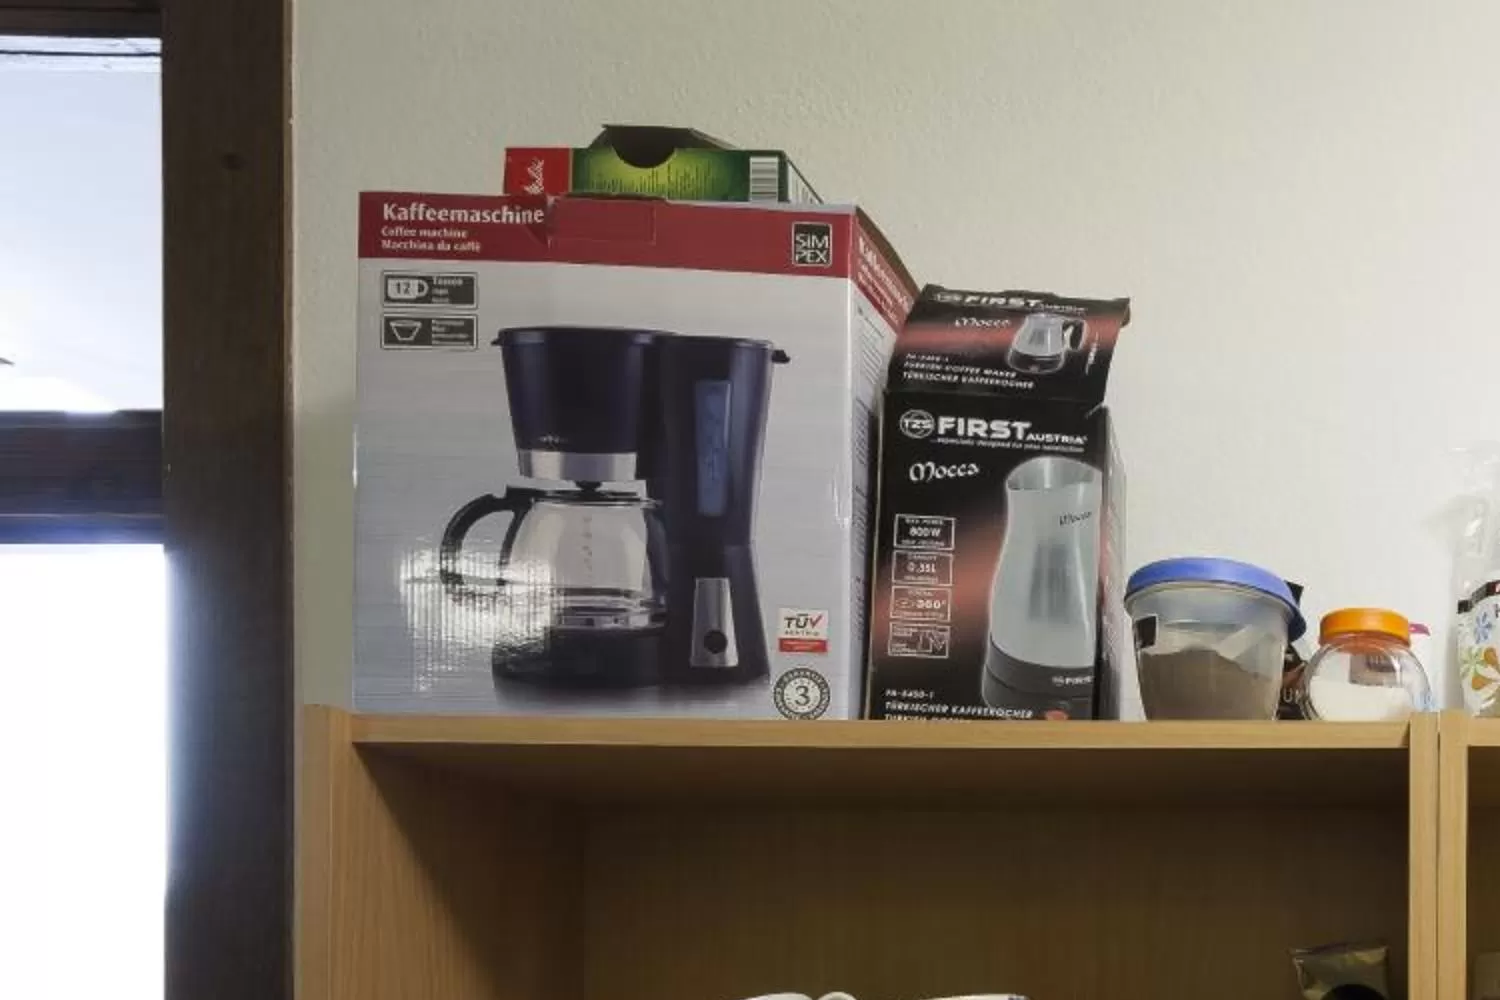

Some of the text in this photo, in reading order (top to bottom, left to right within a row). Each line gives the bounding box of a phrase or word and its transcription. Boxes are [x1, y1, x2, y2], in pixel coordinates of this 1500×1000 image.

[382, 202, 545, 225] Kaffeemaschine
[381, 225, 468, 239] Coffee machine
[795, 233, 829, 250] SIM
[795, 250, 829, 264] PEX
[937, 415, 1032, 441] FIRST
[1026, 432, 1085, 446] AUSTRIA
[908, 460, 980, 483] Mocca
[783, 613, 823, 629] TÜV
[795, 685, 811, 707] 3
